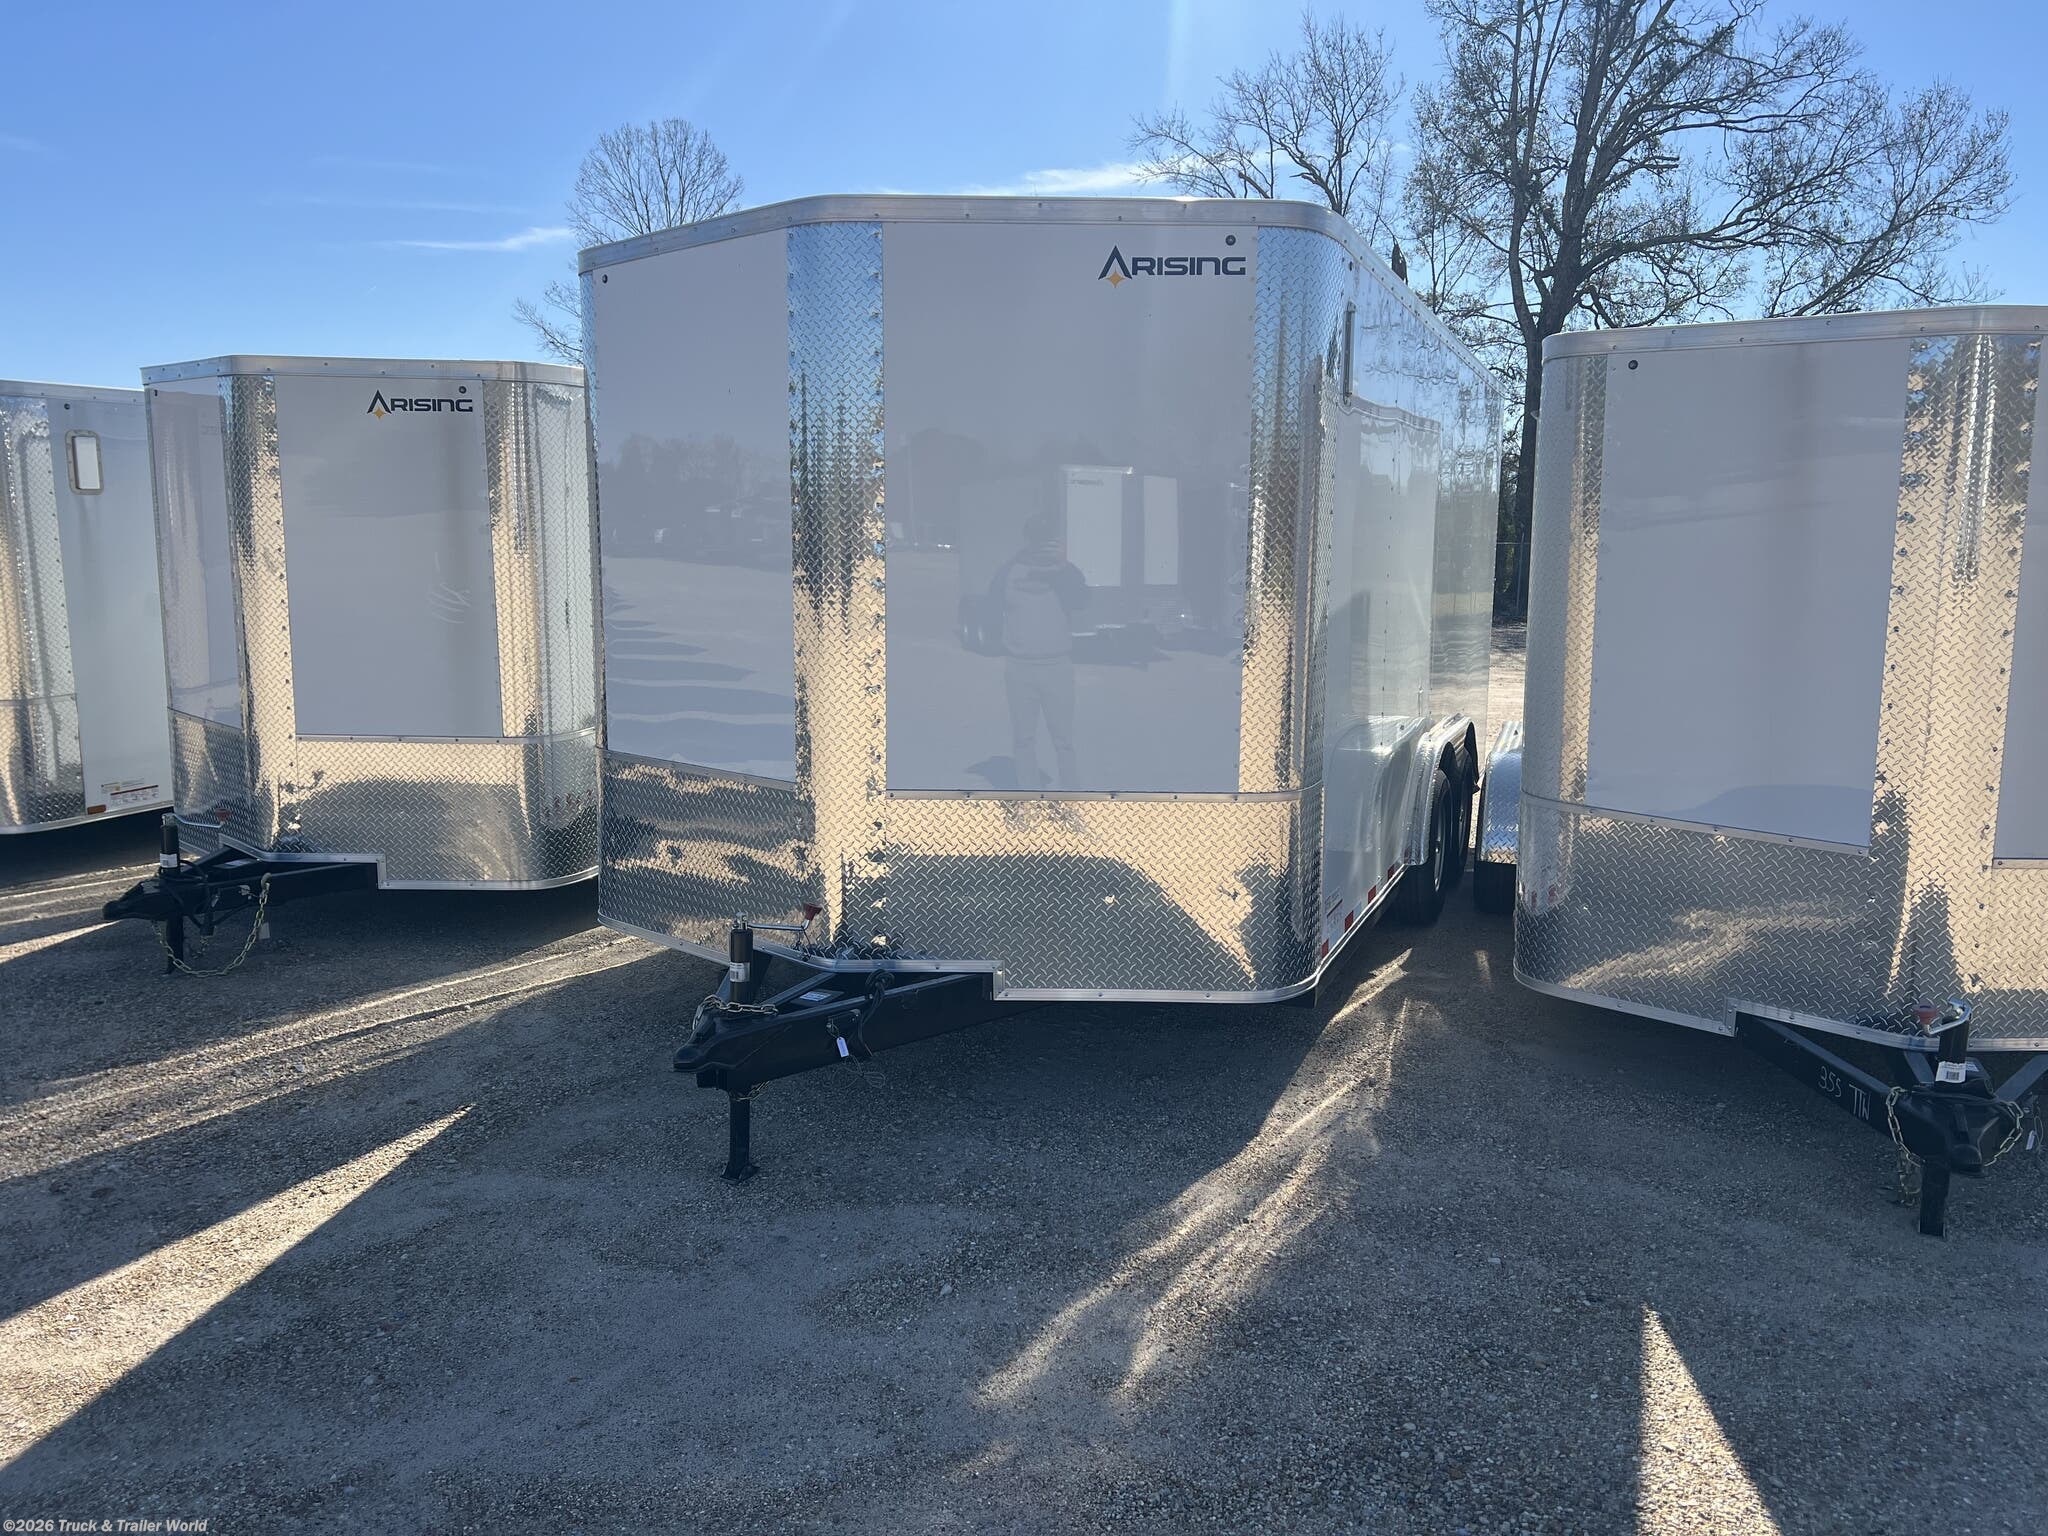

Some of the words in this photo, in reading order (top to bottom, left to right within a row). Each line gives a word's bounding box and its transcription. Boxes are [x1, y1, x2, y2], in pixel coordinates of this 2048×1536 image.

[1098, 245, 1246, 281] ARISING
[367, 389, 473, 414] ARISING
[1818, 1065, 1842, 1098] 355
